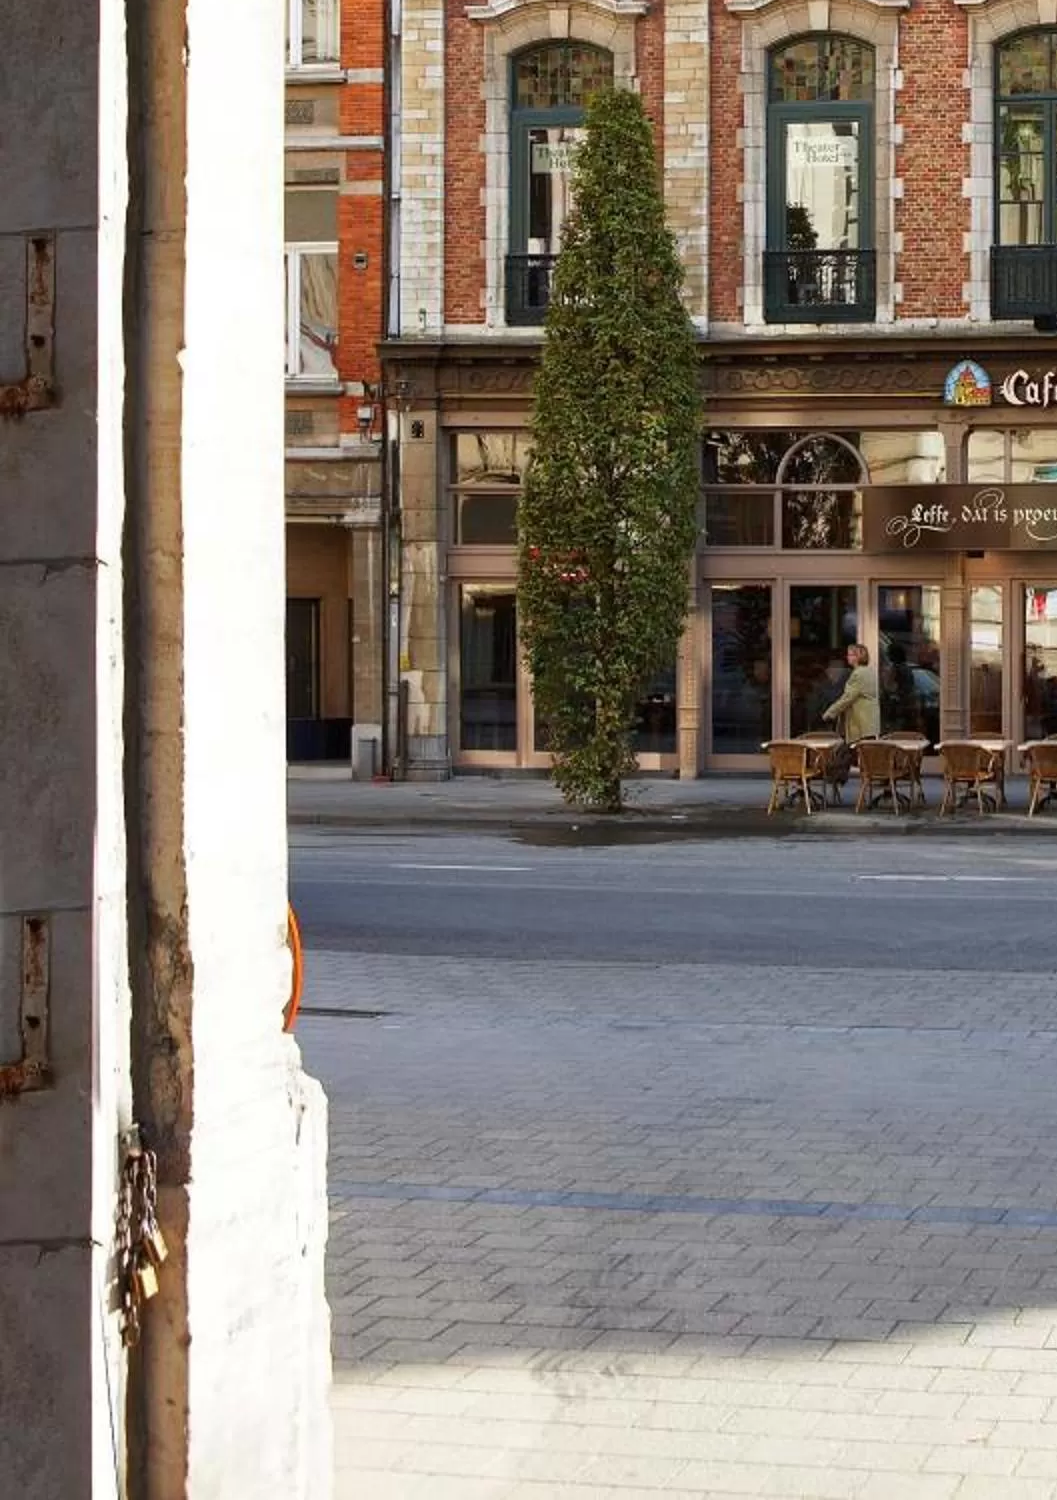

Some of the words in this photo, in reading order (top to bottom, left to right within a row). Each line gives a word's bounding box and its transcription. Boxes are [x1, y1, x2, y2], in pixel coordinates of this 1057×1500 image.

[793, 141, 840, 153] Theater
[806, 149, 839, 162] Hotel
[961, 505, 988, 523] dat
[994, 505, 1008, 523] is
